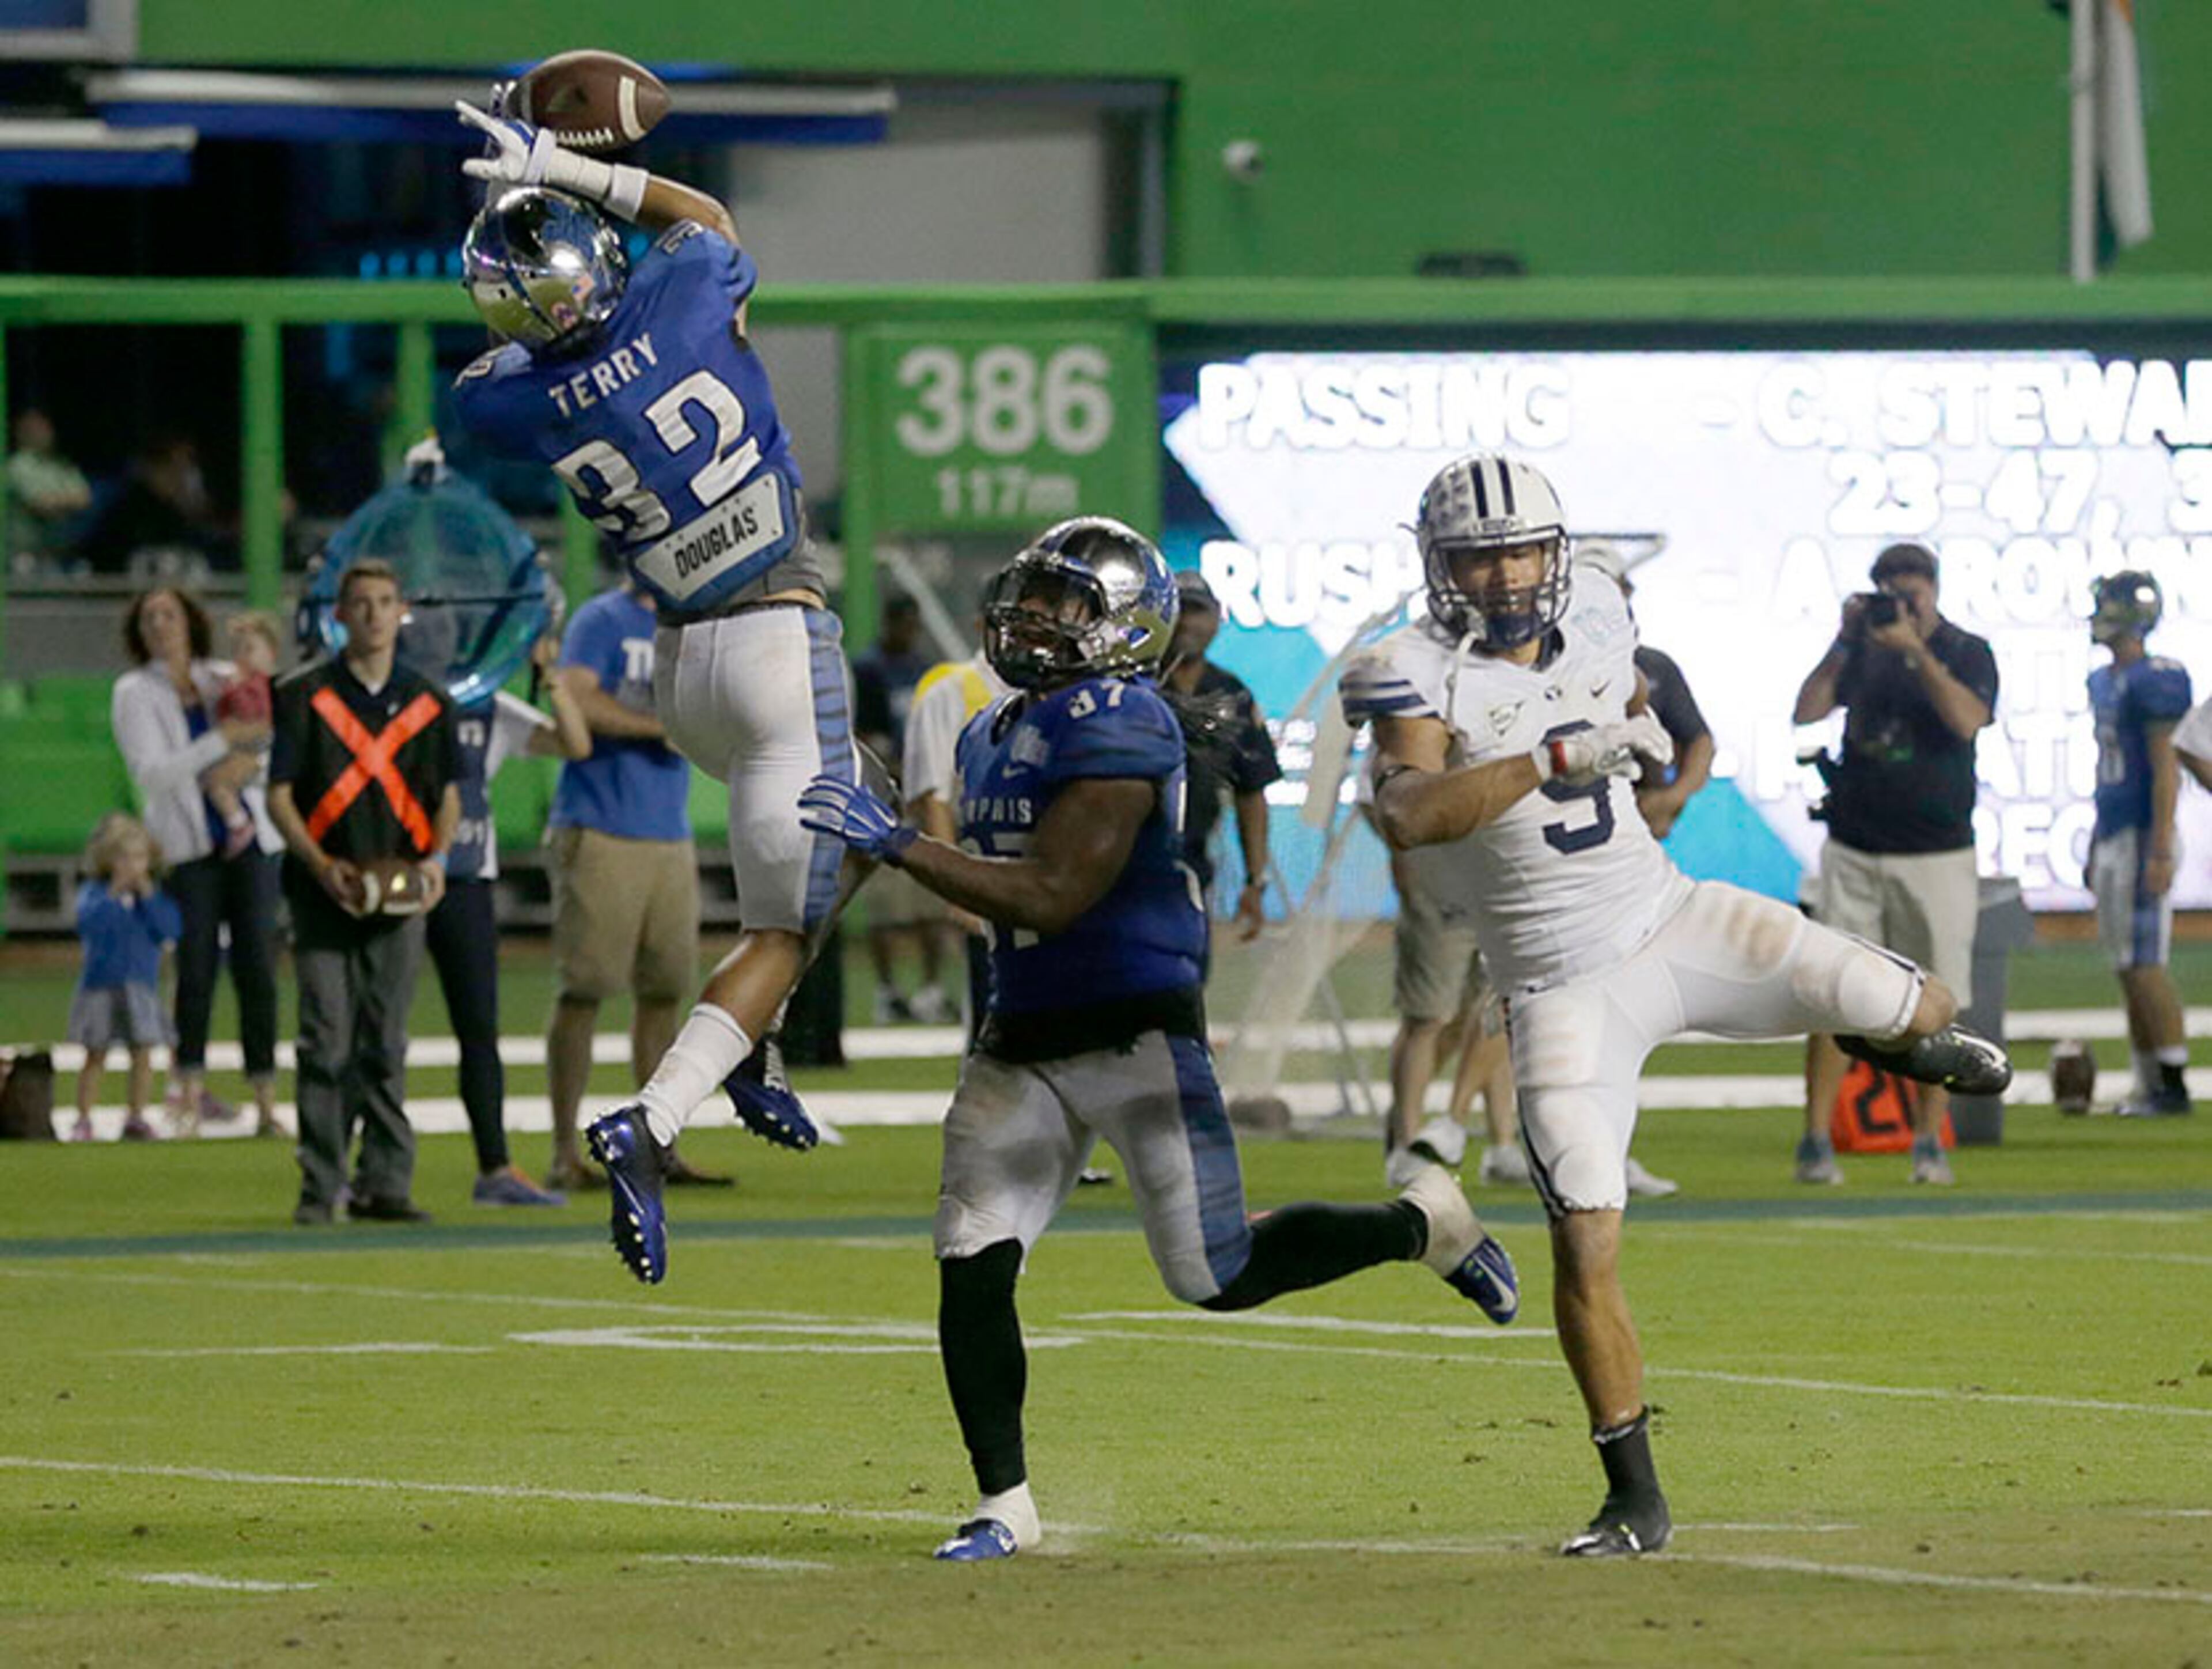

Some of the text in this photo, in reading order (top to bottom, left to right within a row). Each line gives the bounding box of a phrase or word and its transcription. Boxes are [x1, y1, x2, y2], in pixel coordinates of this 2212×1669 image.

[548, 332, 658, 418] TERRY
[895, 343, 1113, 456] 386
[1199, 365, 1569, 449] PASSING
[551, 370, 762, 544] 32
[674, 506, 759, 580] DOUGLAS
[1201, 543, 1423, 626] RUSH
[1067, 682, 1124, 719] 37
